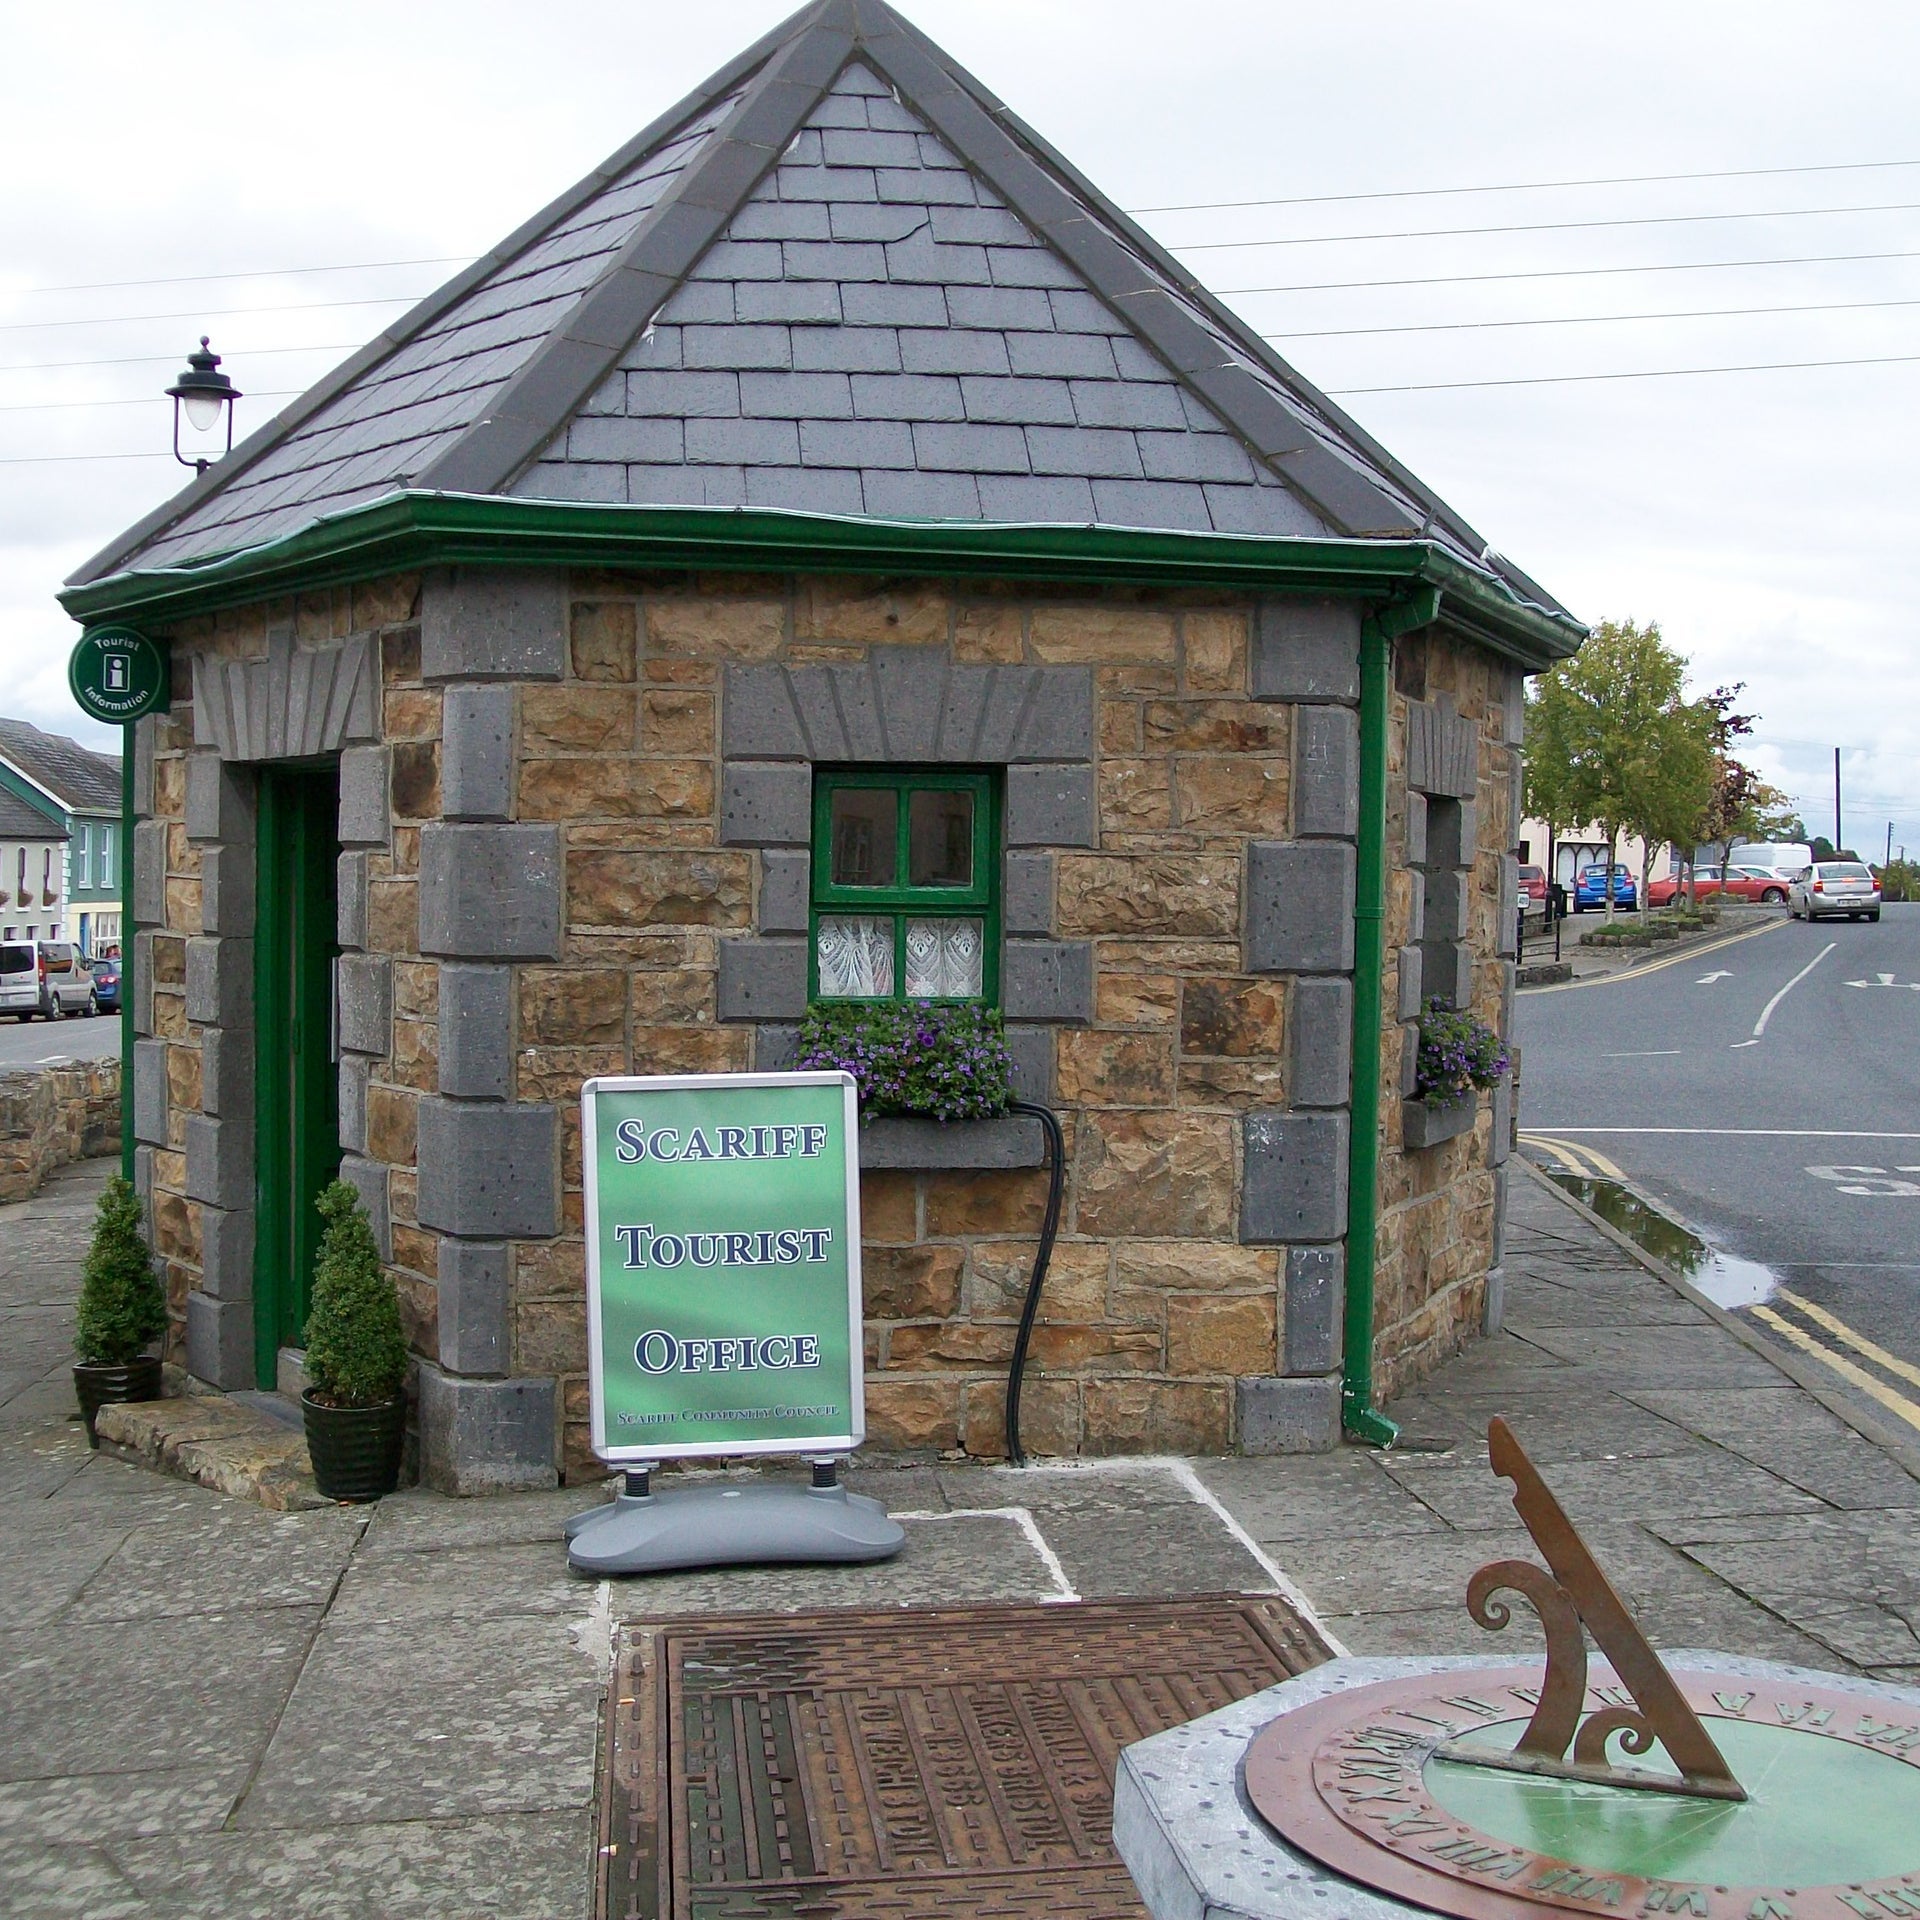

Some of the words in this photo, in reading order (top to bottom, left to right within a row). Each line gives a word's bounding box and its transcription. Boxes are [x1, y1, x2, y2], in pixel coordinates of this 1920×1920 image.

[94, 637, 141, 653] Tourist
[85, 686, 149, 711] Information
[616, 1118, 827, 1163] SCARIFF
[615, 1223, 833, 1270] TOURIST
[634, 1329, 821, 1375] OFFICE
[616, 1411, 678, 1426] SCARIFF
[682, 1407, 772, 1423] COMMUNITY
[774, 1403, 841, 1418] COUNCIL
[969, 1695, 1028, 1762] MAKERS
[1021, 1691, 1094, 1768] PARNALL
[864, 1729, 919, 1790] WEIGH
[886, 1809, 938, 1856] TON
[996, 1767, 1071, 1851] BRISTOL
